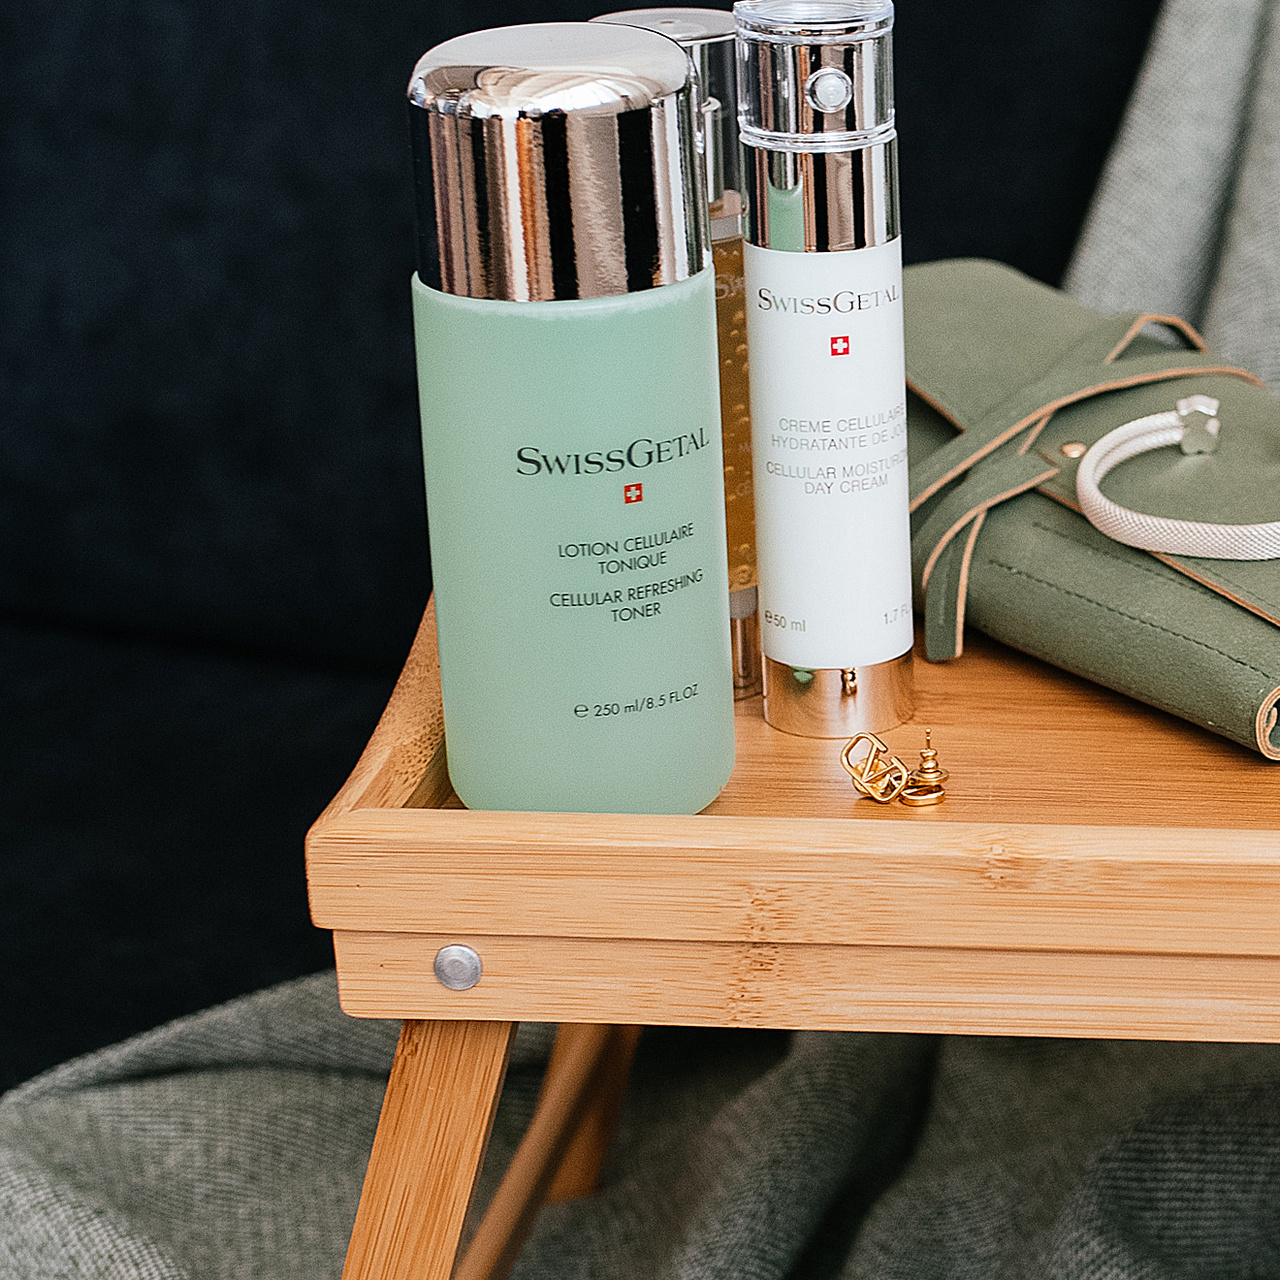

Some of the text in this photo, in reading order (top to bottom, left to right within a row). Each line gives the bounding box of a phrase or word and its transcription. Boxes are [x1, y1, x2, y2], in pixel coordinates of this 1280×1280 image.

[779, 418, 831, 433] CREME
[772, 434, 867, 451] HYDRATANTE
[871, 429, 888, 445] DE
[766, 461, 836, 479] CELLULAR
[804, 473, 889, 495] DAY CREAM
[558, 522, 695, 557] LOTION CELLULAIRE
[598, 551, 668, 574] TONIQUE
[549, 568, 704, 607] CELLULAR REFRESHING
[611, 602, 662, 622] TONER
[790, 619, 807, 632] ml
[593, 703, 620, 717] 250
[624, 694, 667, 713] ml/8.5
[669, 683, 699, 703] FL.OZ
